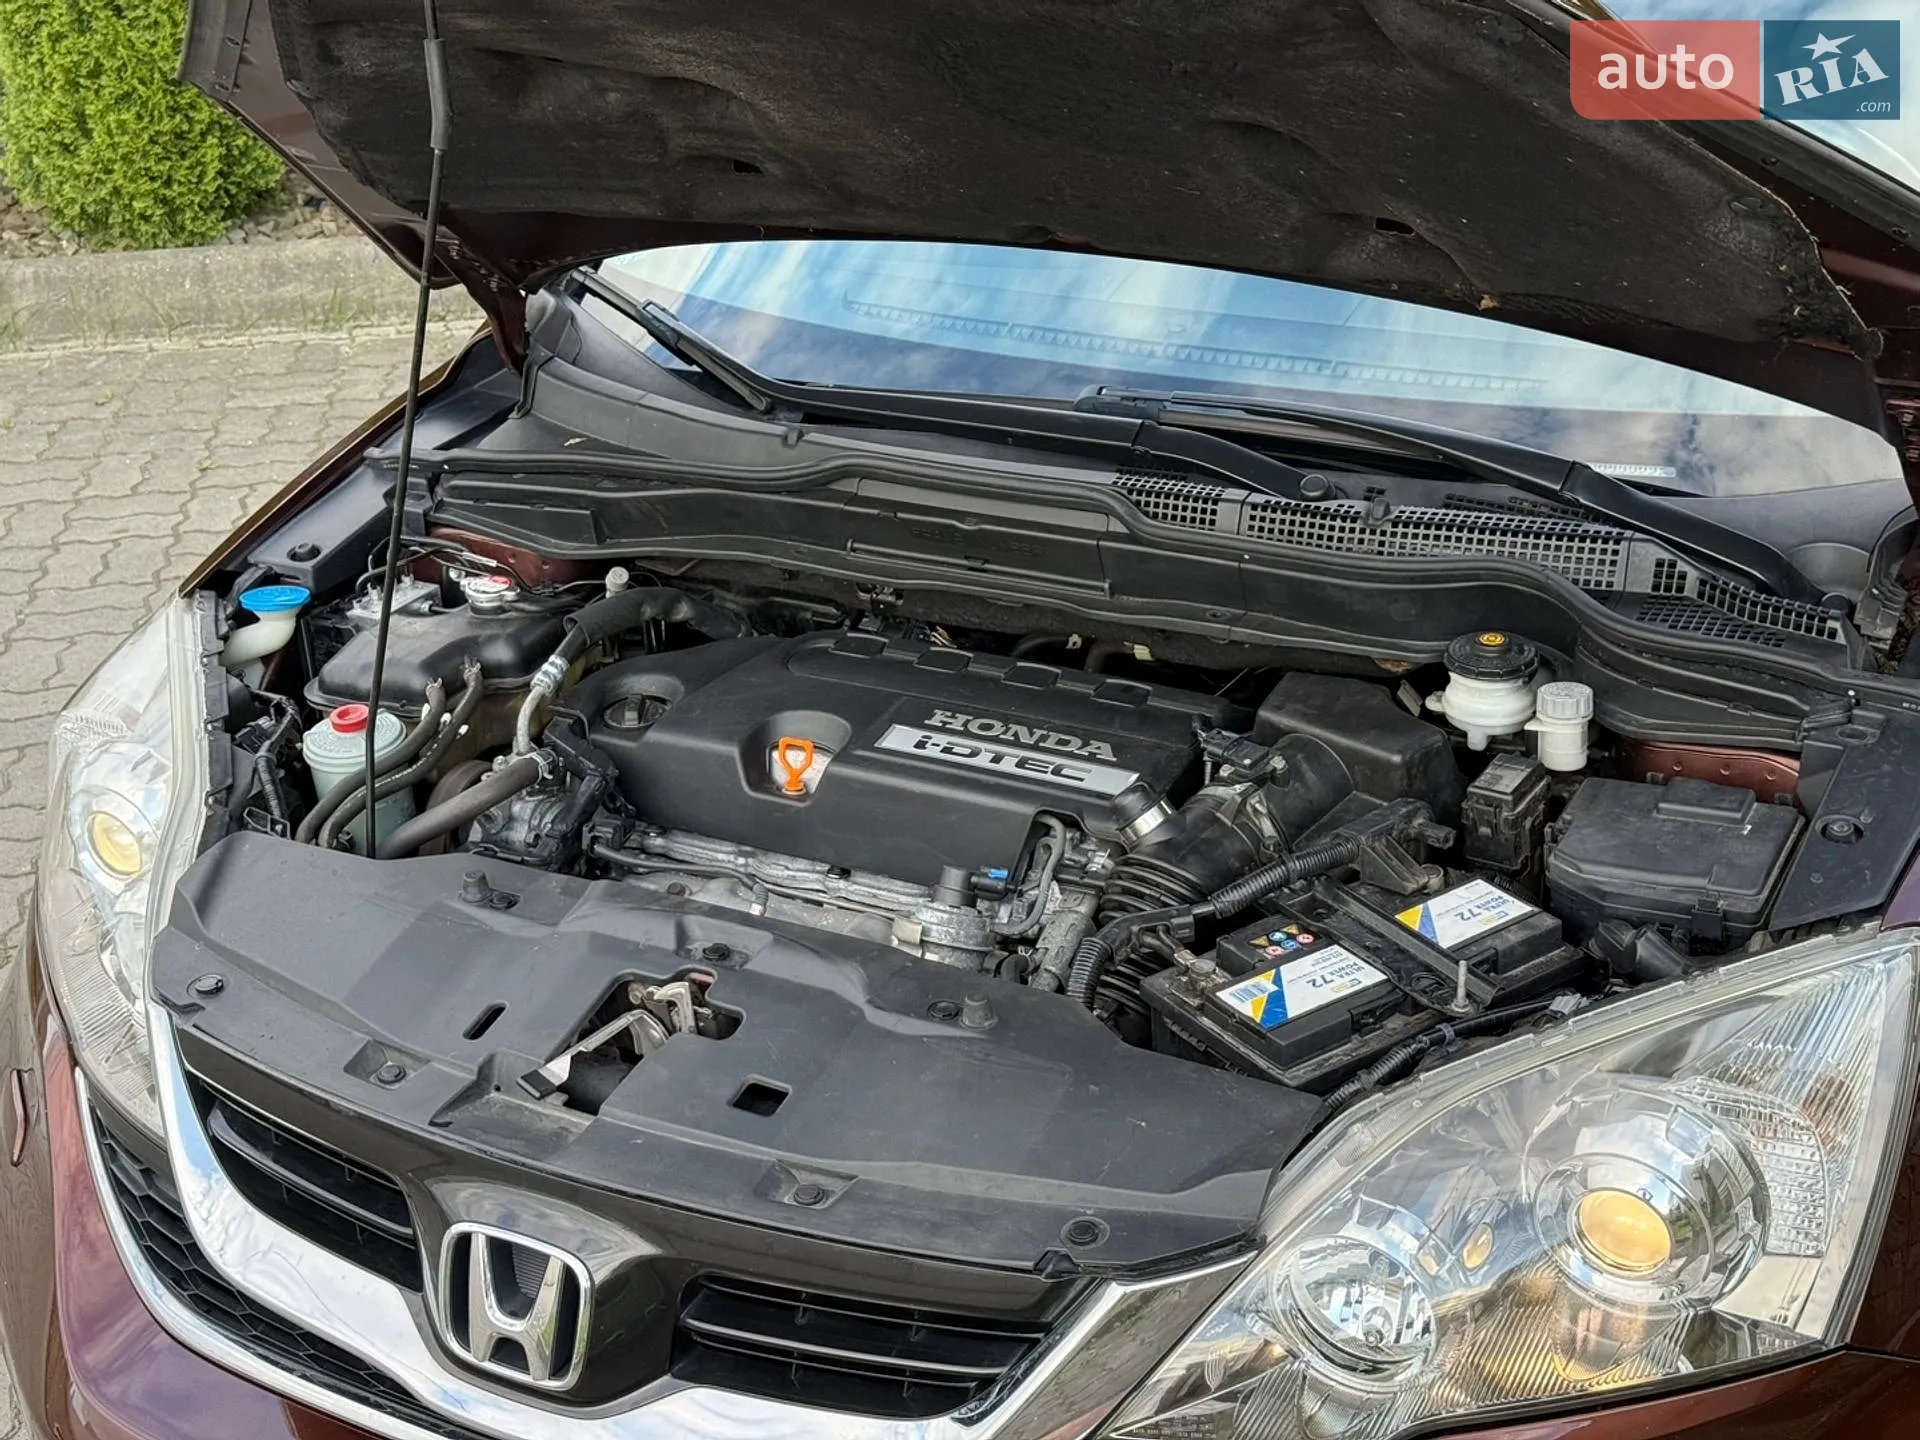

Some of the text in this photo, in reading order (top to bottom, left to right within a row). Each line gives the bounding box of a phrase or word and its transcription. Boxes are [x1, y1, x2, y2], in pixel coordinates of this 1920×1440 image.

[924, 709, 1117, 761] HONDA
[913, 735, 1093, 782] i-DTEC
[1453, 908, 1482, 921] 72
[1305, 974, 1335, 988] 72
